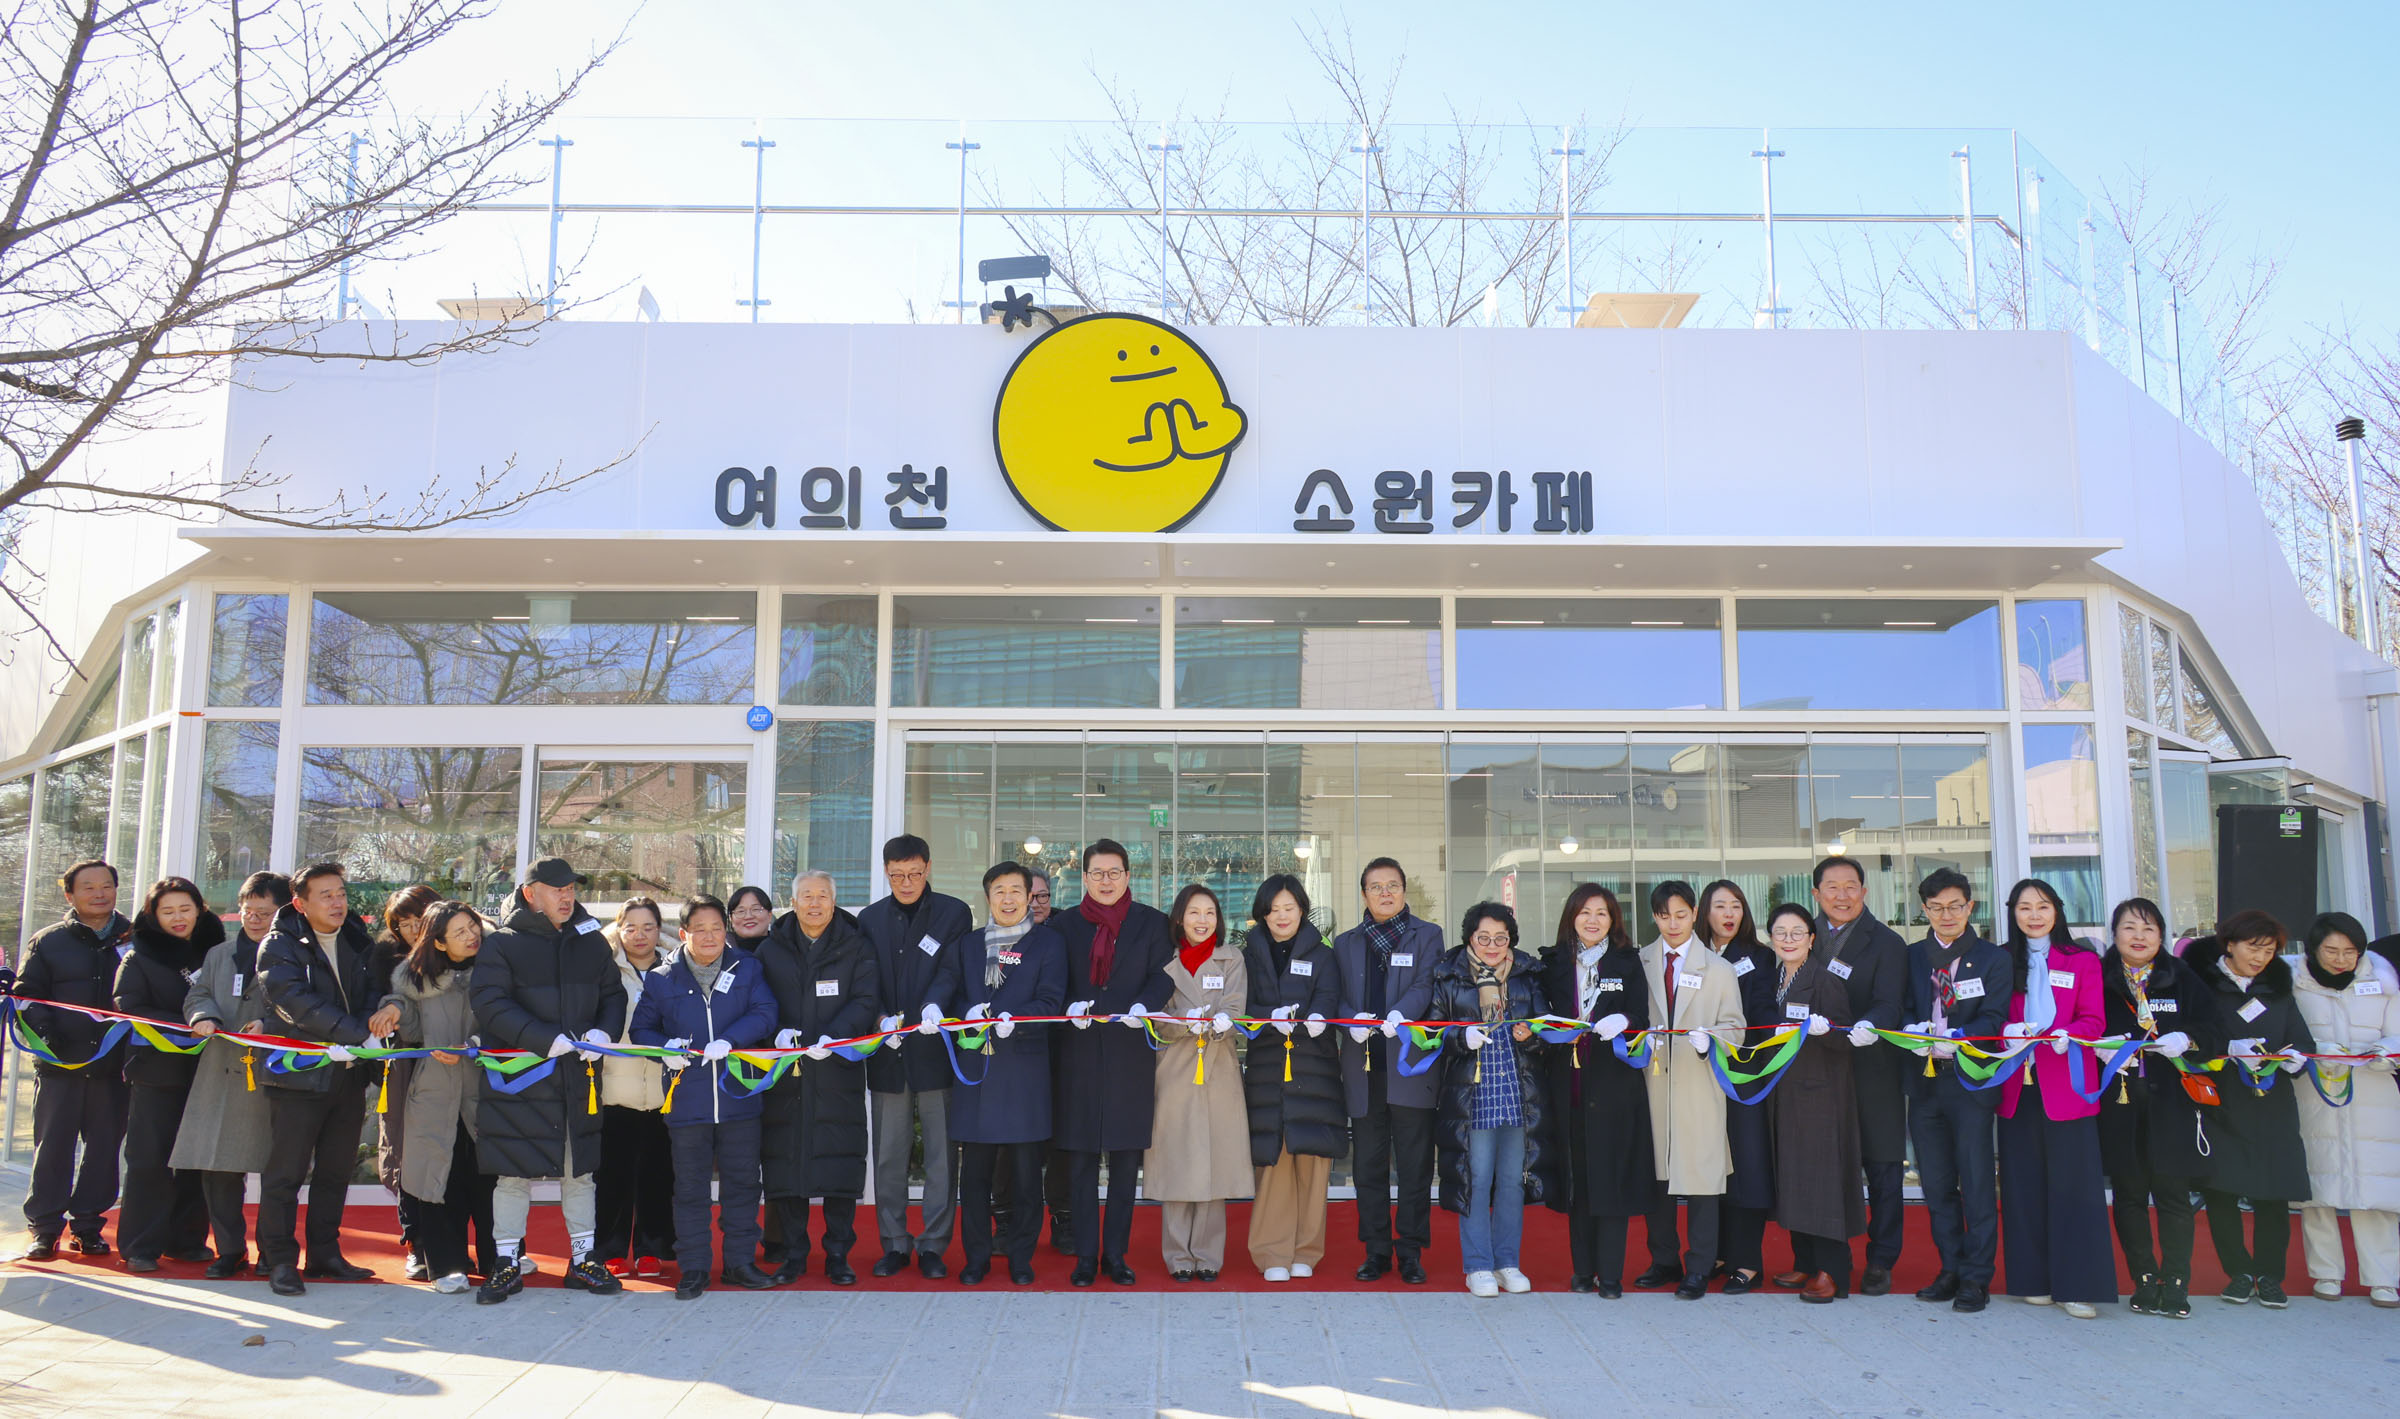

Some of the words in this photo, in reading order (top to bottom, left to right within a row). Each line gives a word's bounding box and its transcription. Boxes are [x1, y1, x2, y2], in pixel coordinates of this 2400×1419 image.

[715, 464, 947, 530] 여의천
[1293, 469, 1594, 533] 소원카페
[751, 713, 768, 722] ADT
